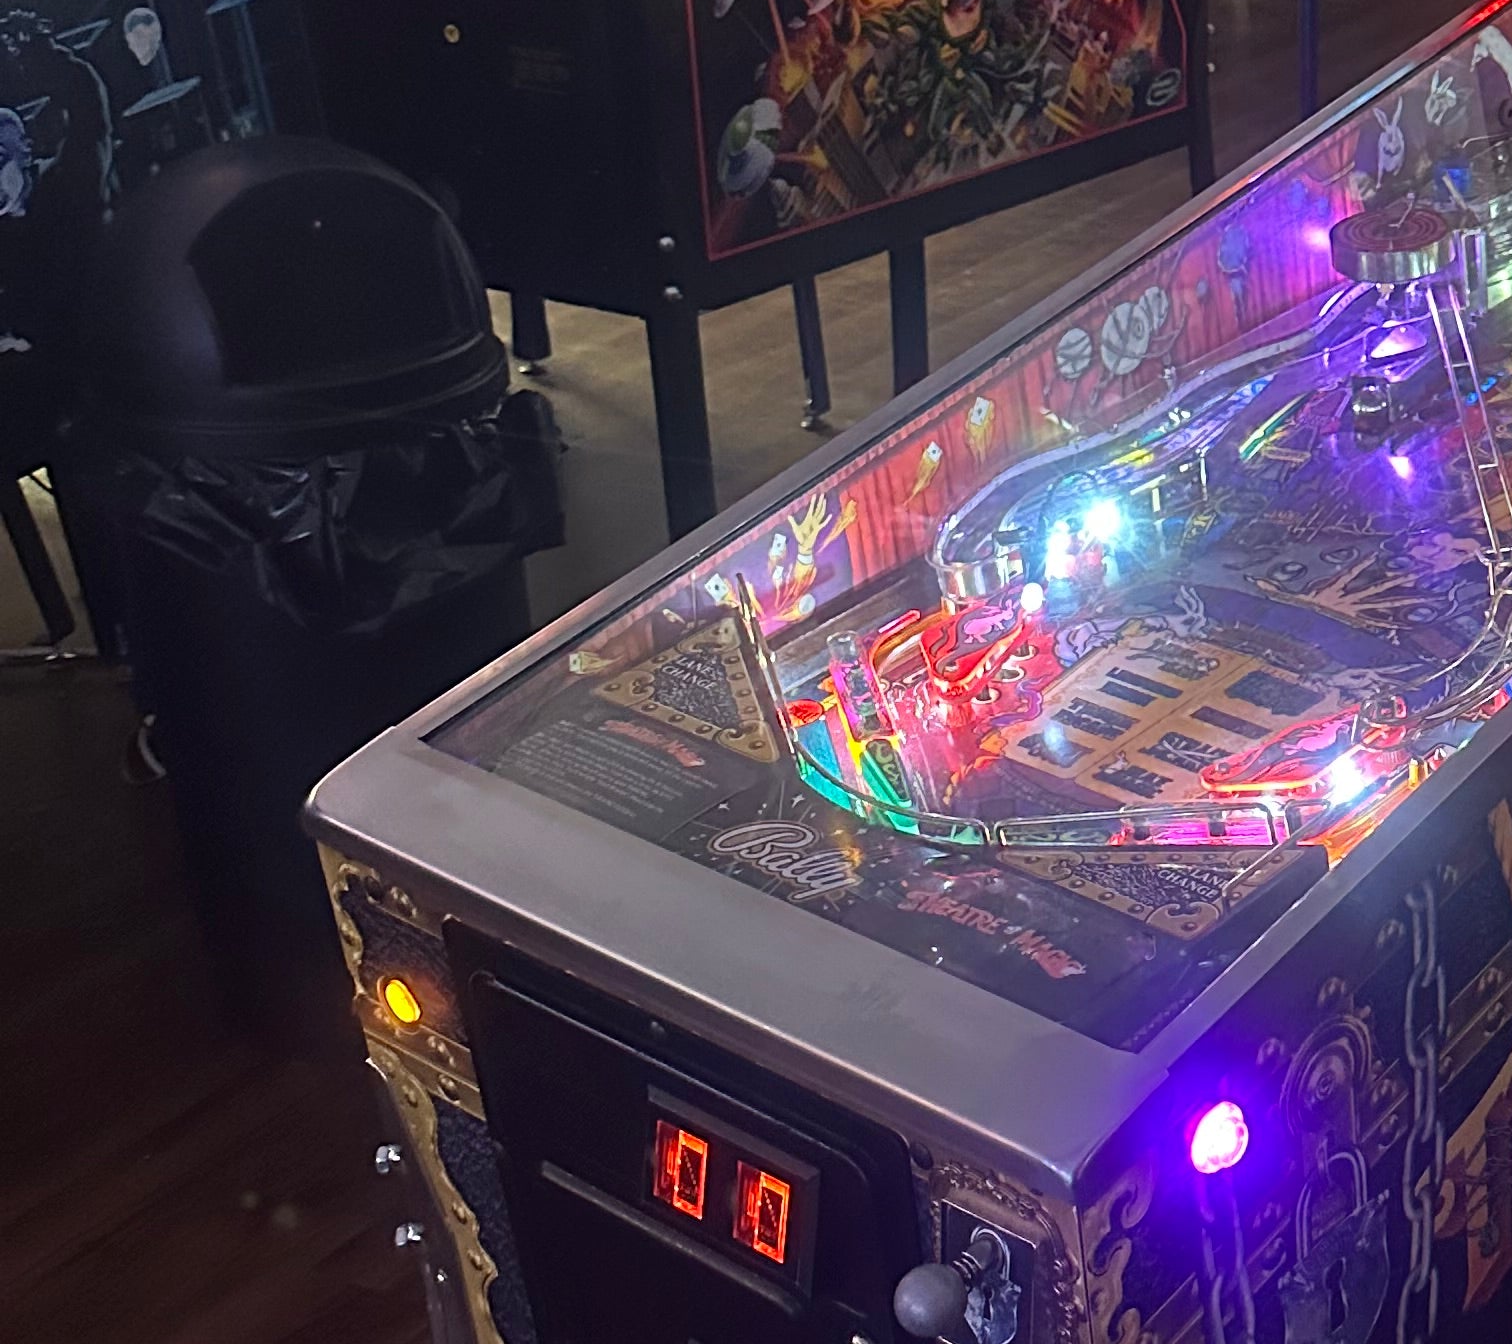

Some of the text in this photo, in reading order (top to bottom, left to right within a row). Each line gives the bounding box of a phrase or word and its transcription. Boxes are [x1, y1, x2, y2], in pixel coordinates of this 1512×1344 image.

[662, 665, 718, 690] CHANGE
[710, 820, 864, 903] Bally
[1157, 869, 1219, 899] CHANGE
